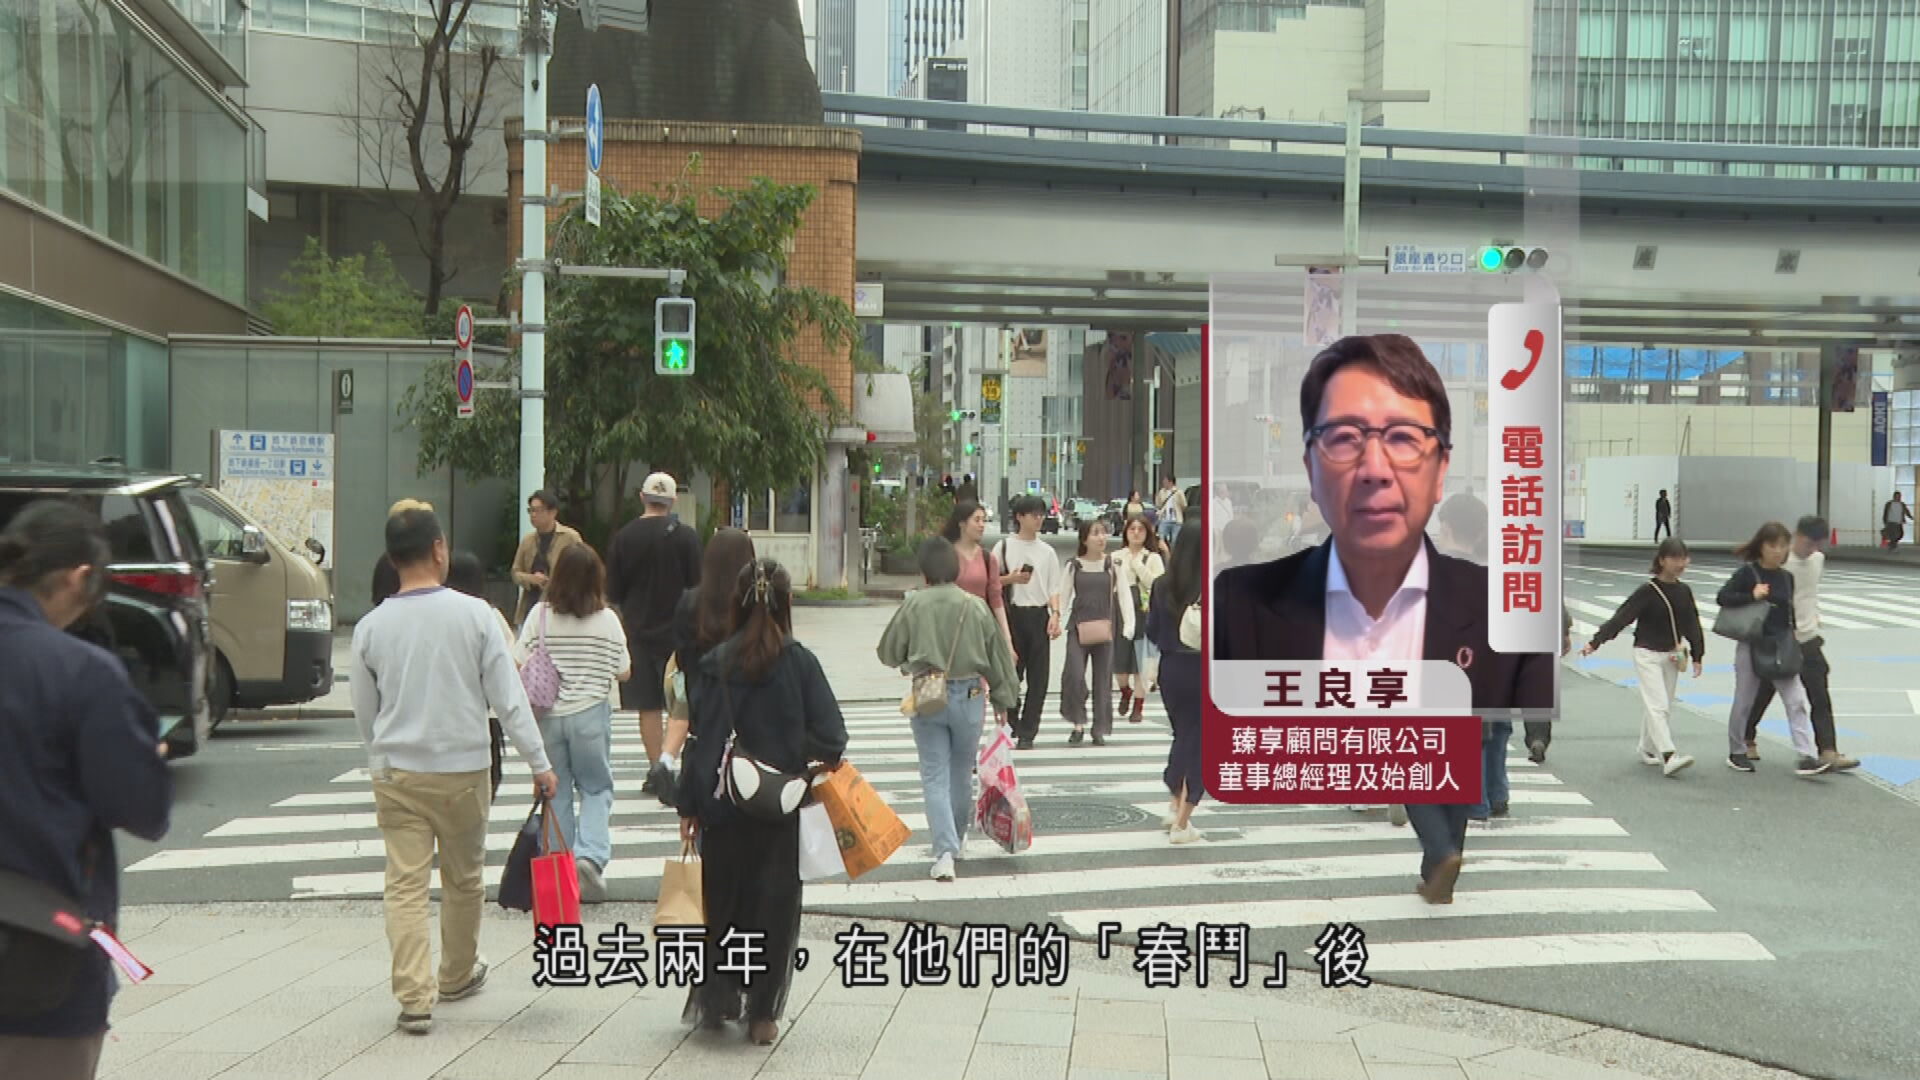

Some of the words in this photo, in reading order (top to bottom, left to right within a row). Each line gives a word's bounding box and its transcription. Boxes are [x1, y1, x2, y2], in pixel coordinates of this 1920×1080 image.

[1394, 252, 1464, 265] 銀座通り口
